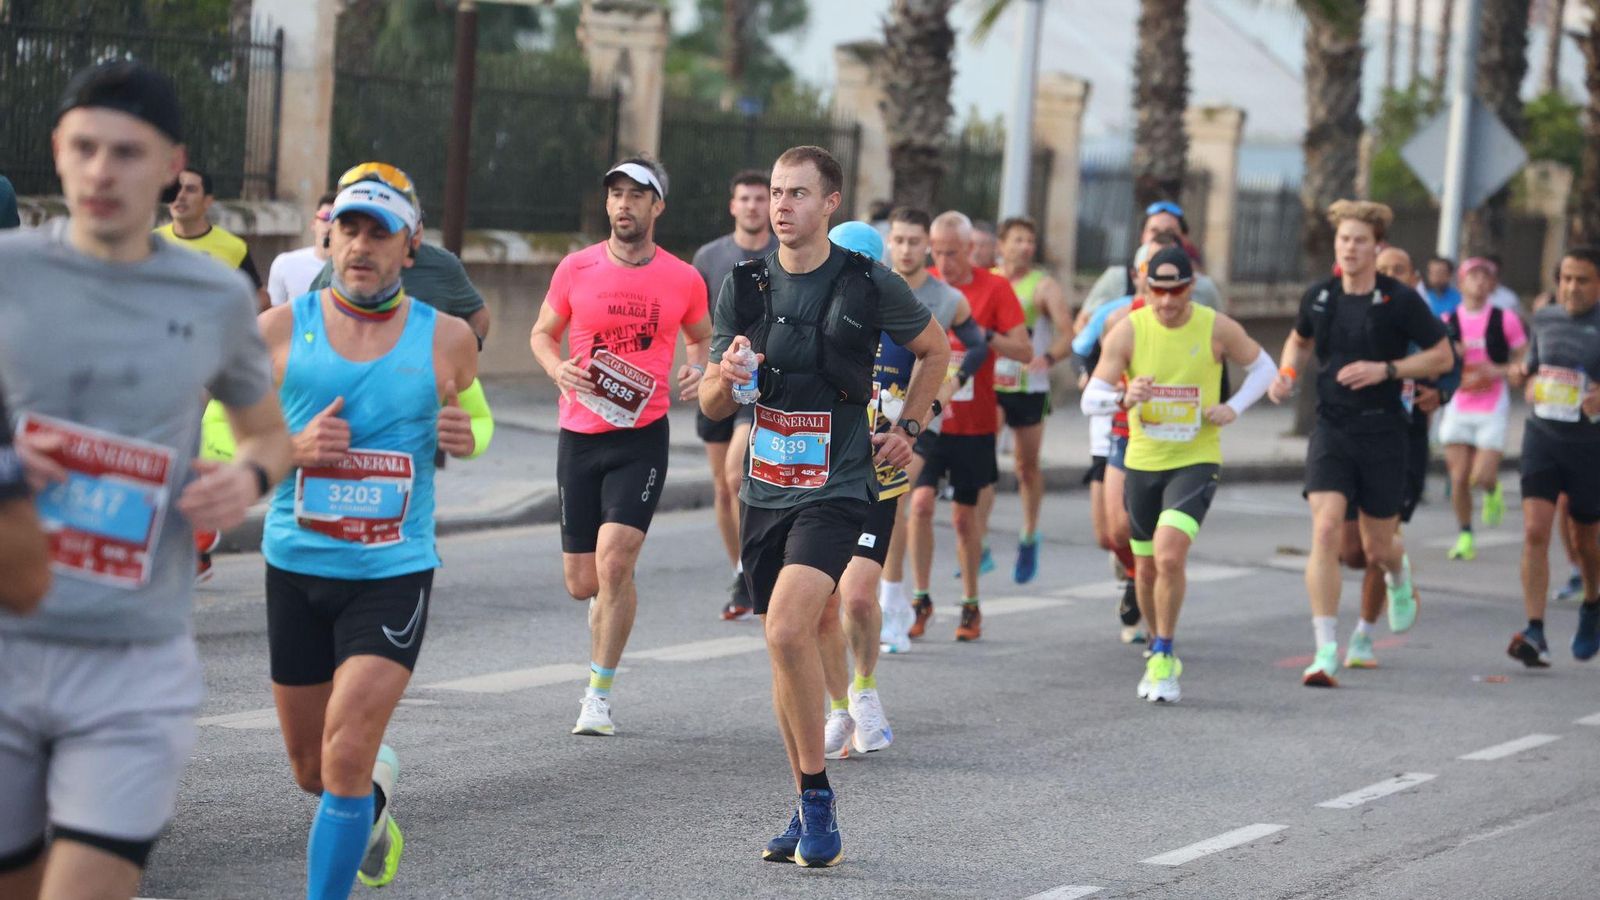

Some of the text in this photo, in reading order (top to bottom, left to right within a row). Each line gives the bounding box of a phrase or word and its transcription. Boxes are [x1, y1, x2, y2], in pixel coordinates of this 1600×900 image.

[597, 372, 636, 402] 16835
[773, 413, 825, 428] GENERALI
[770, 436, 807, 455] 5239
[338, 454, 406, 473] ENERALI
[328, 484, 383, 505] 3203
